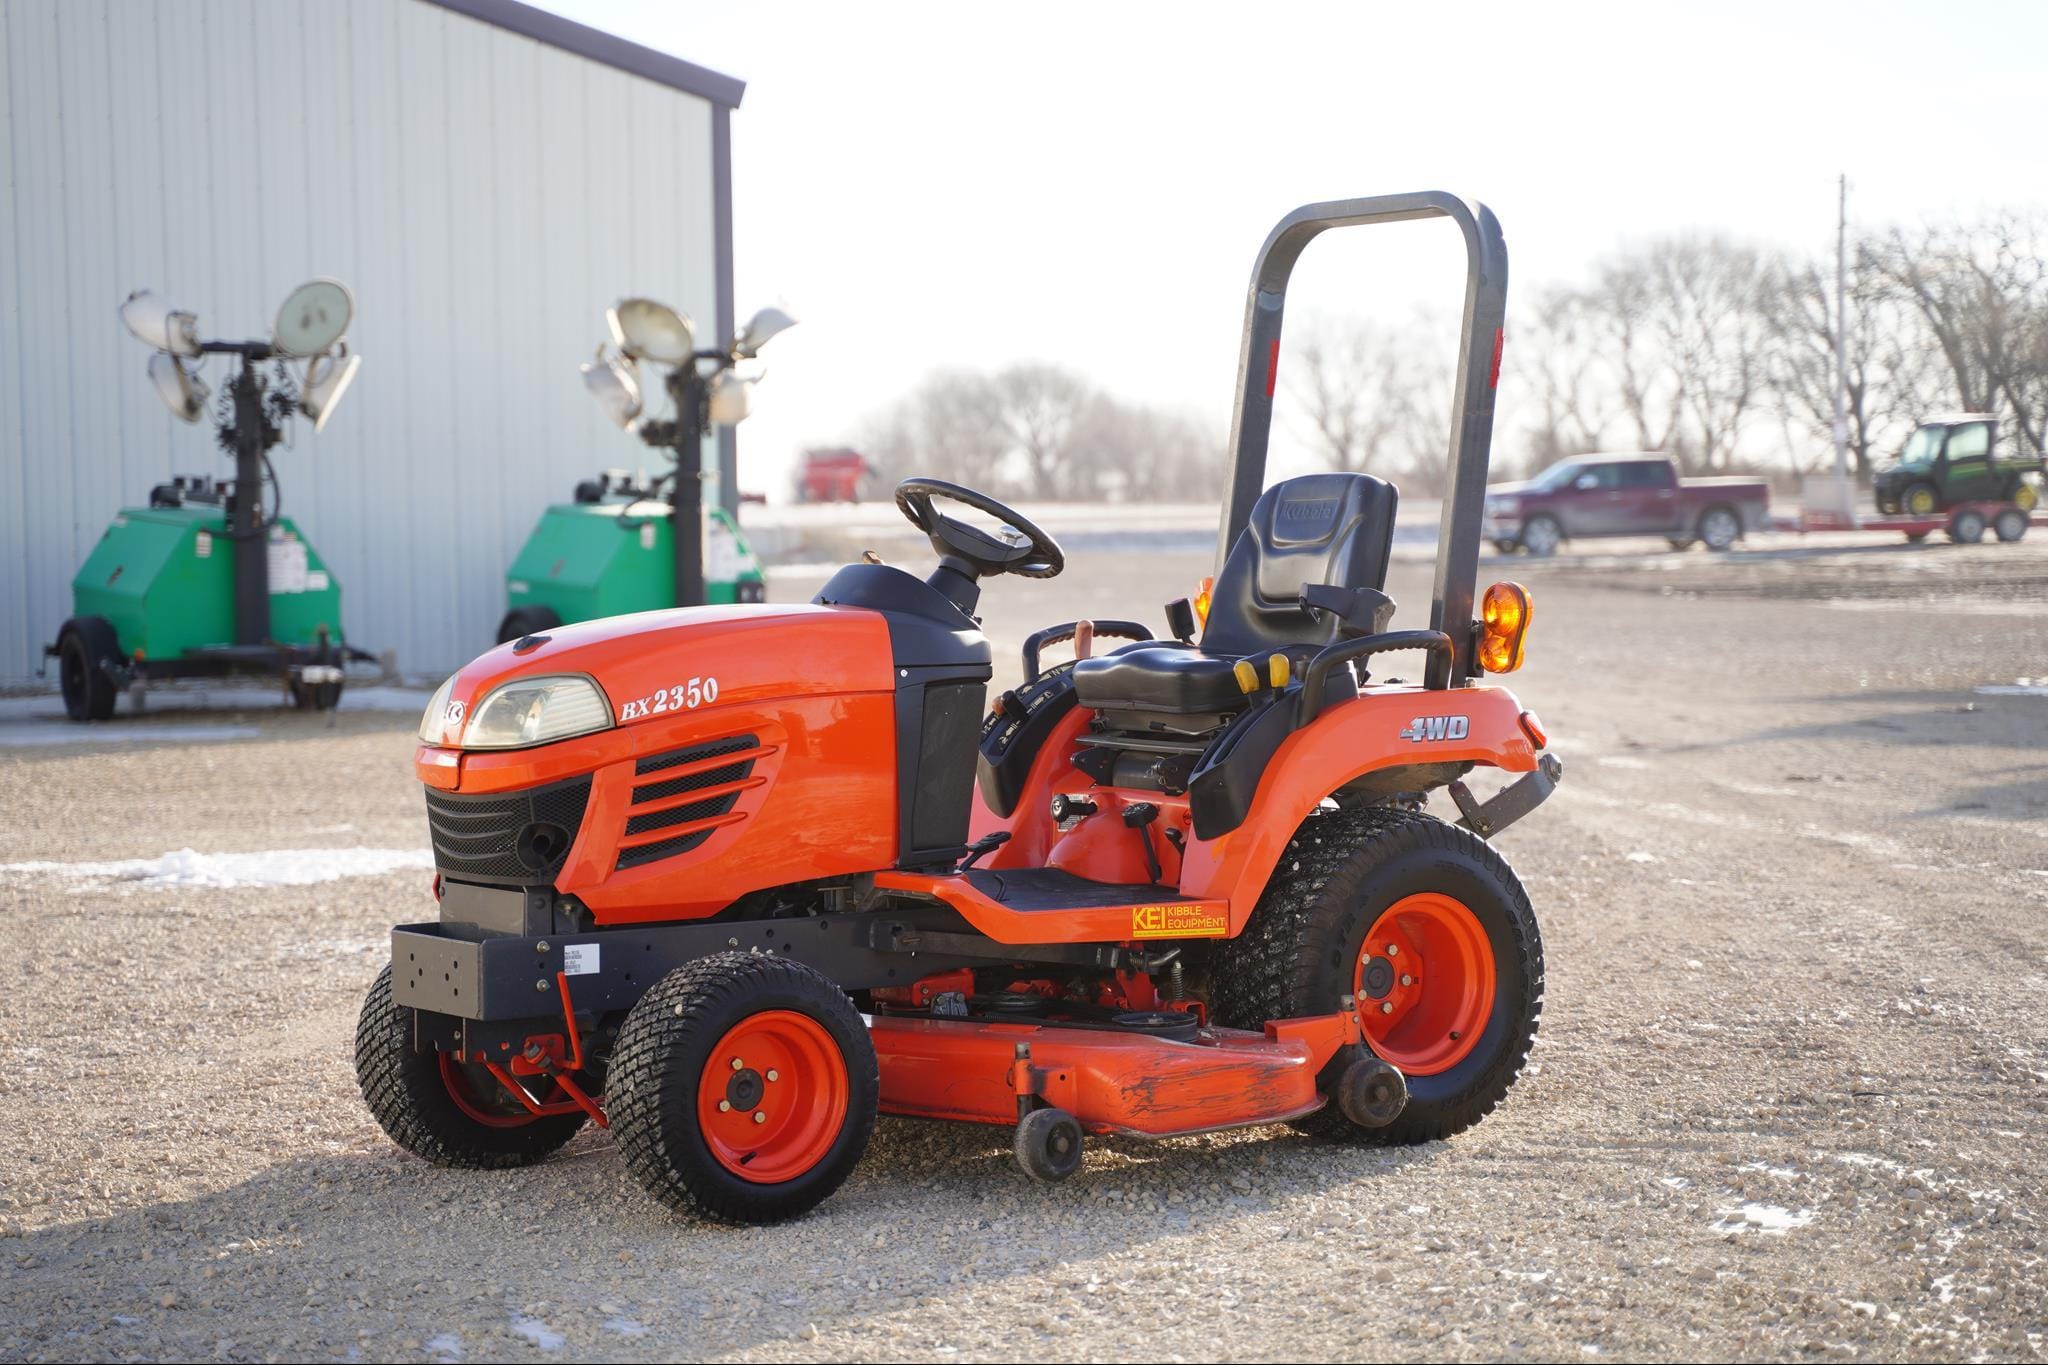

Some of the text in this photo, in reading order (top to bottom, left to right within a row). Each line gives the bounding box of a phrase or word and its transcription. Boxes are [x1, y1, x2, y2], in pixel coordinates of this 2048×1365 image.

[1400, 714, 1471, 742] 4WD
[1132, 905, 1203, 930] KEI KIBBLE
[1167, 917, 1226, 929] EQUIPMENT
